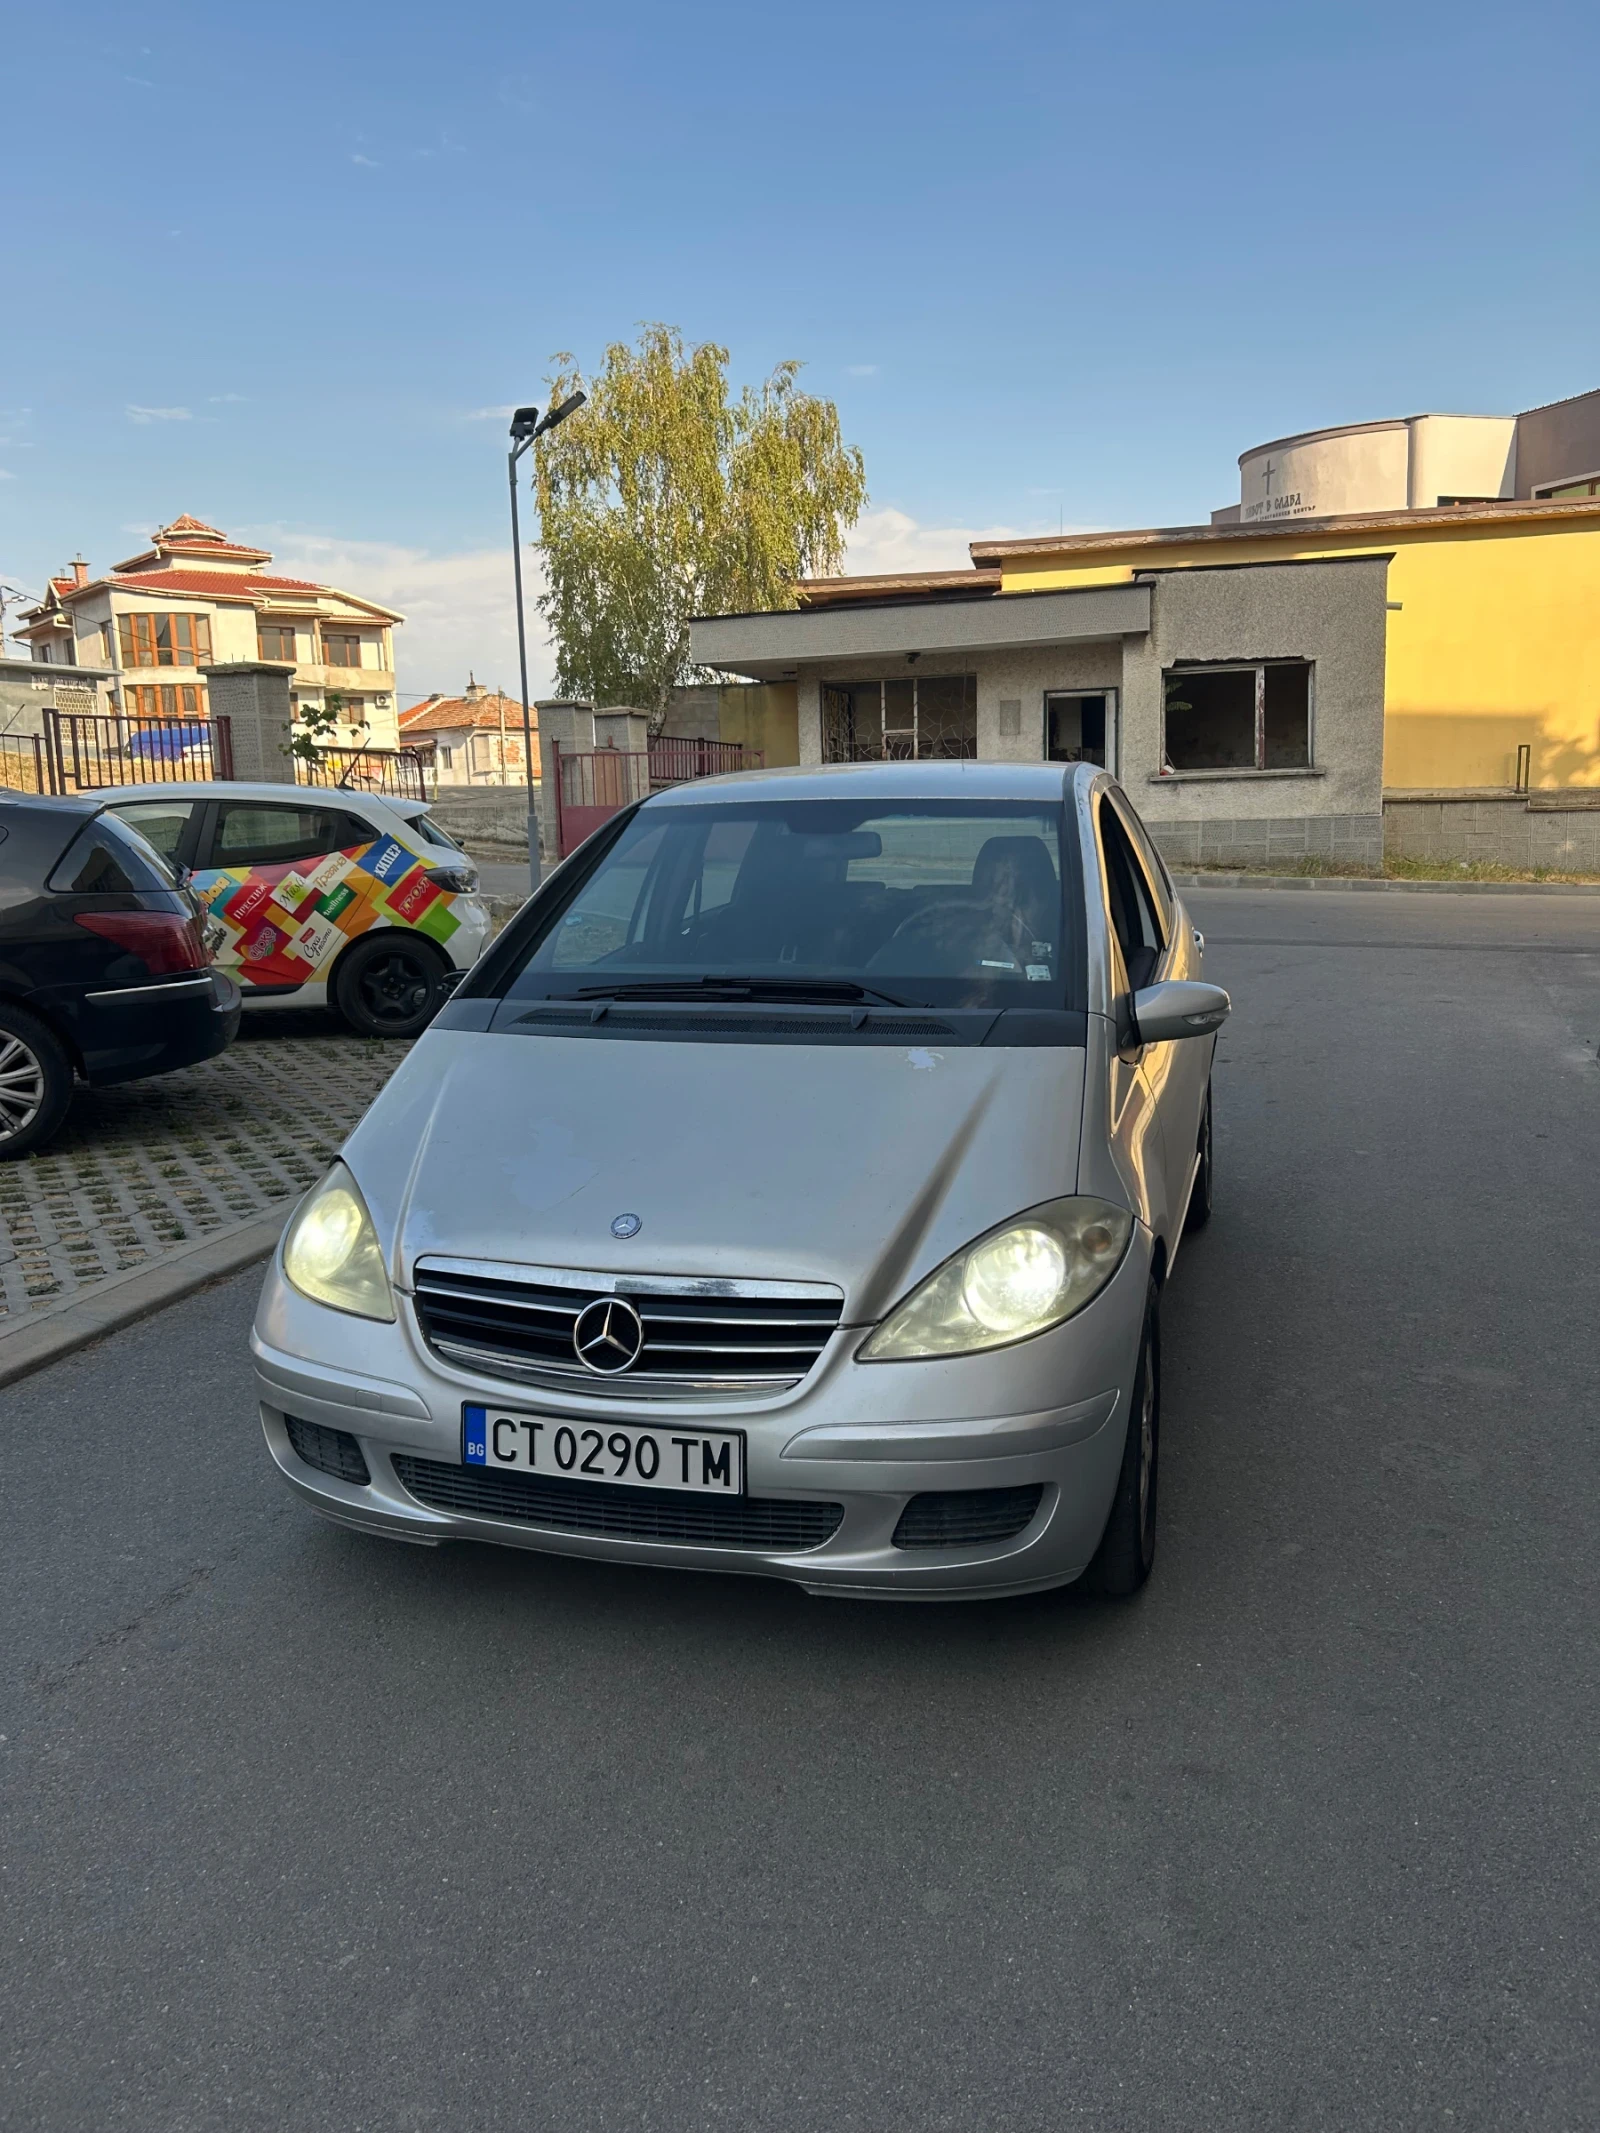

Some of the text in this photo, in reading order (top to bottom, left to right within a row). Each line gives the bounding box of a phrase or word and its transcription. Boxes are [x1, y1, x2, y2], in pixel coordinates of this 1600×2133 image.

[1275, 493, 1301, 510] СЛАВА
[313, 856, 347, 888] Траяна
[374, 844, 402, 878] ХИПЕР
[233, 884, 268, 920] ПРЕСТИЖ
[323, 888, 349, 916] wellness
[468, 1441, 484, 1457] BG
[492, 1417, 731, 1487] CT 0290 TM
